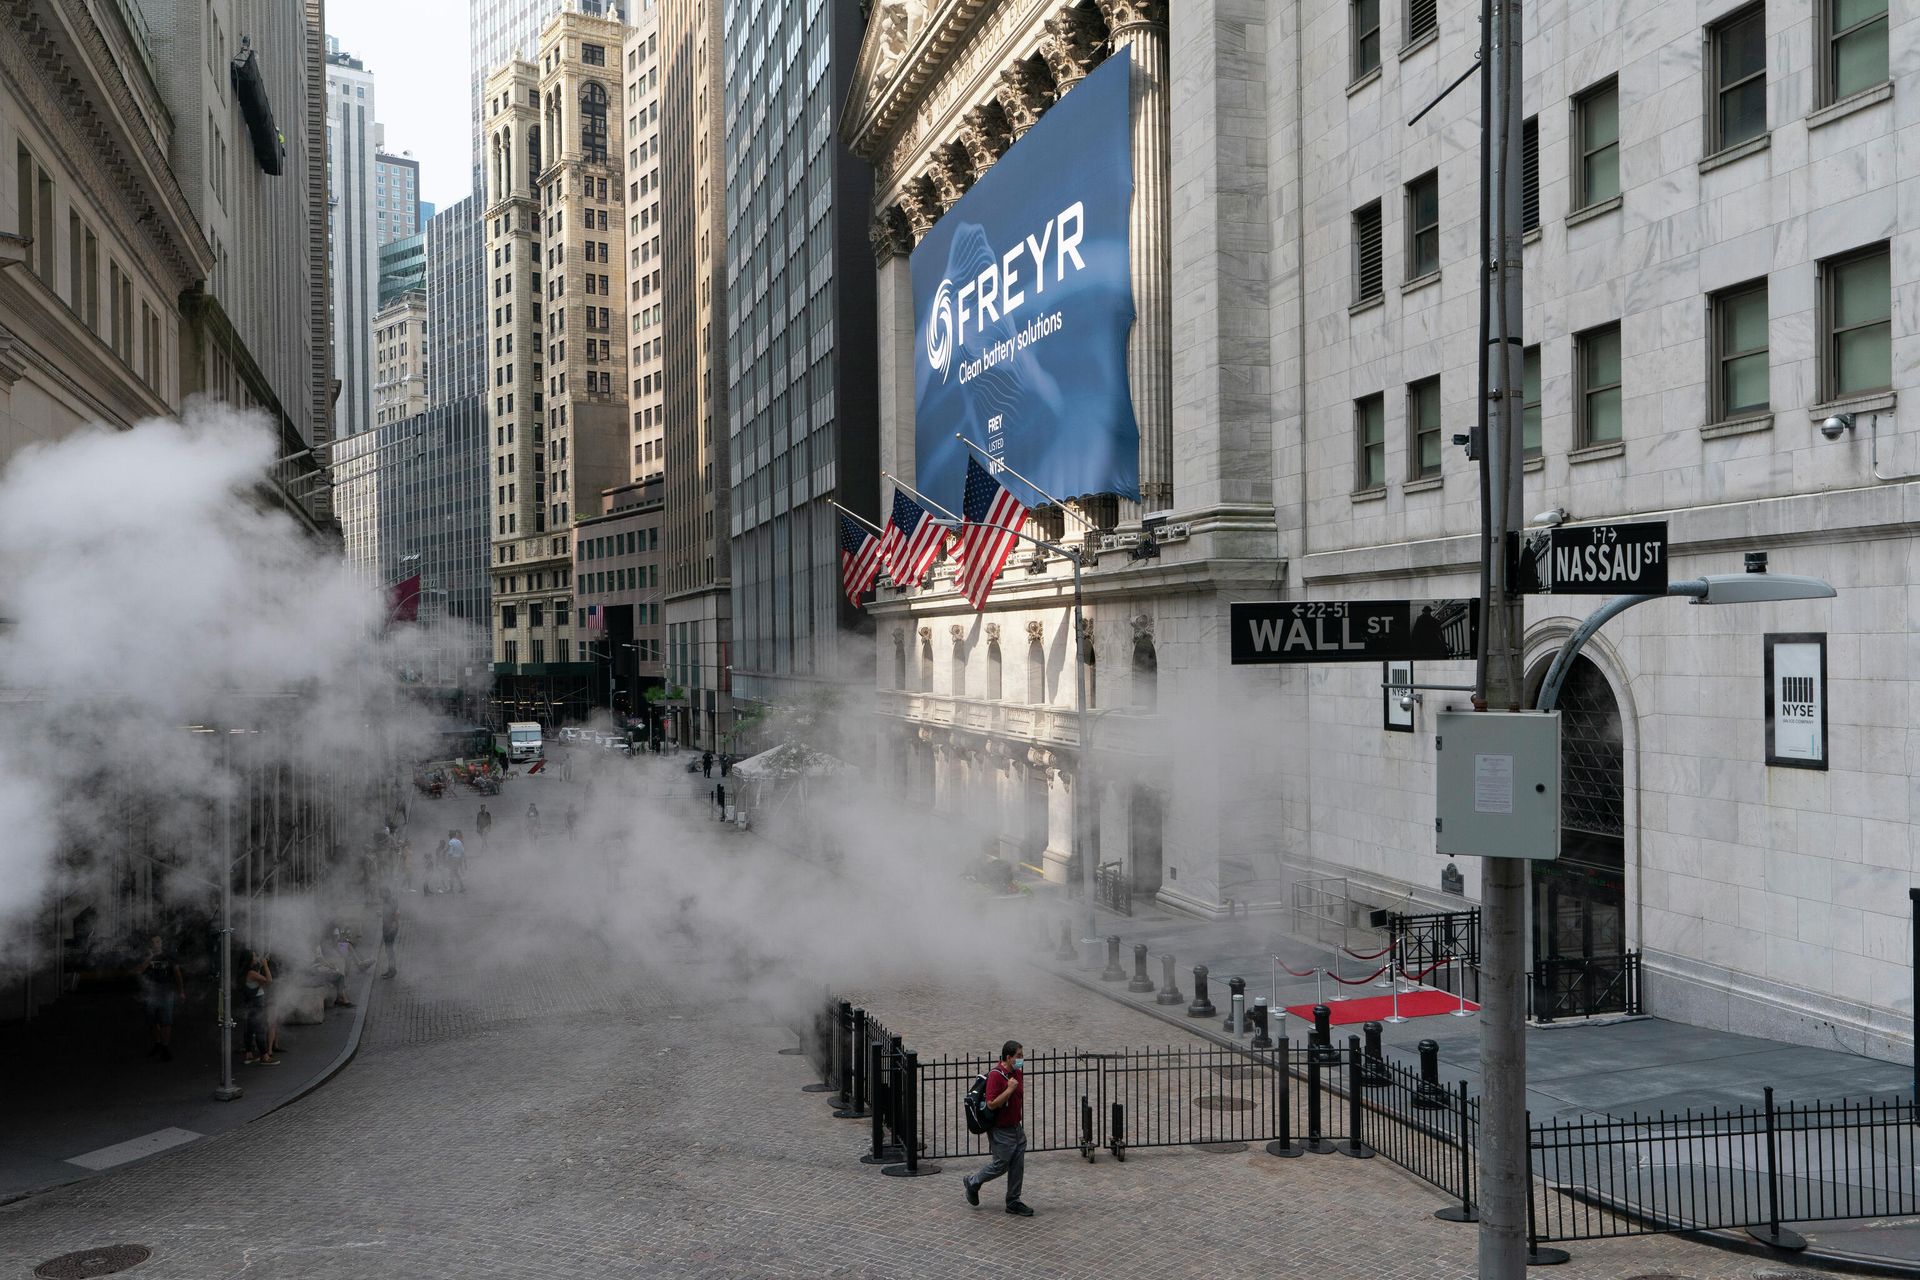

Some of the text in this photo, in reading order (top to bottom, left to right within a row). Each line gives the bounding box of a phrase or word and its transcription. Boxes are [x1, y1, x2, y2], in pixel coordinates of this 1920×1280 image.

[958, 201, 1086, 346] FREYR
[959, 311, 1063, 385] Clean battery solutions
[988, 413, 1003, 434] FREY
[989, 438, 1004, 452] LISTED
[1592, 527, 1607, 544] 1-7
[1556, 541, 1661, 582] NASSAU ST
[1307, 602, 1349, 618] 22-51
[1248, 616, 1394, 652] WALL ST
[1782, 704, 1814, 717] NYSE
